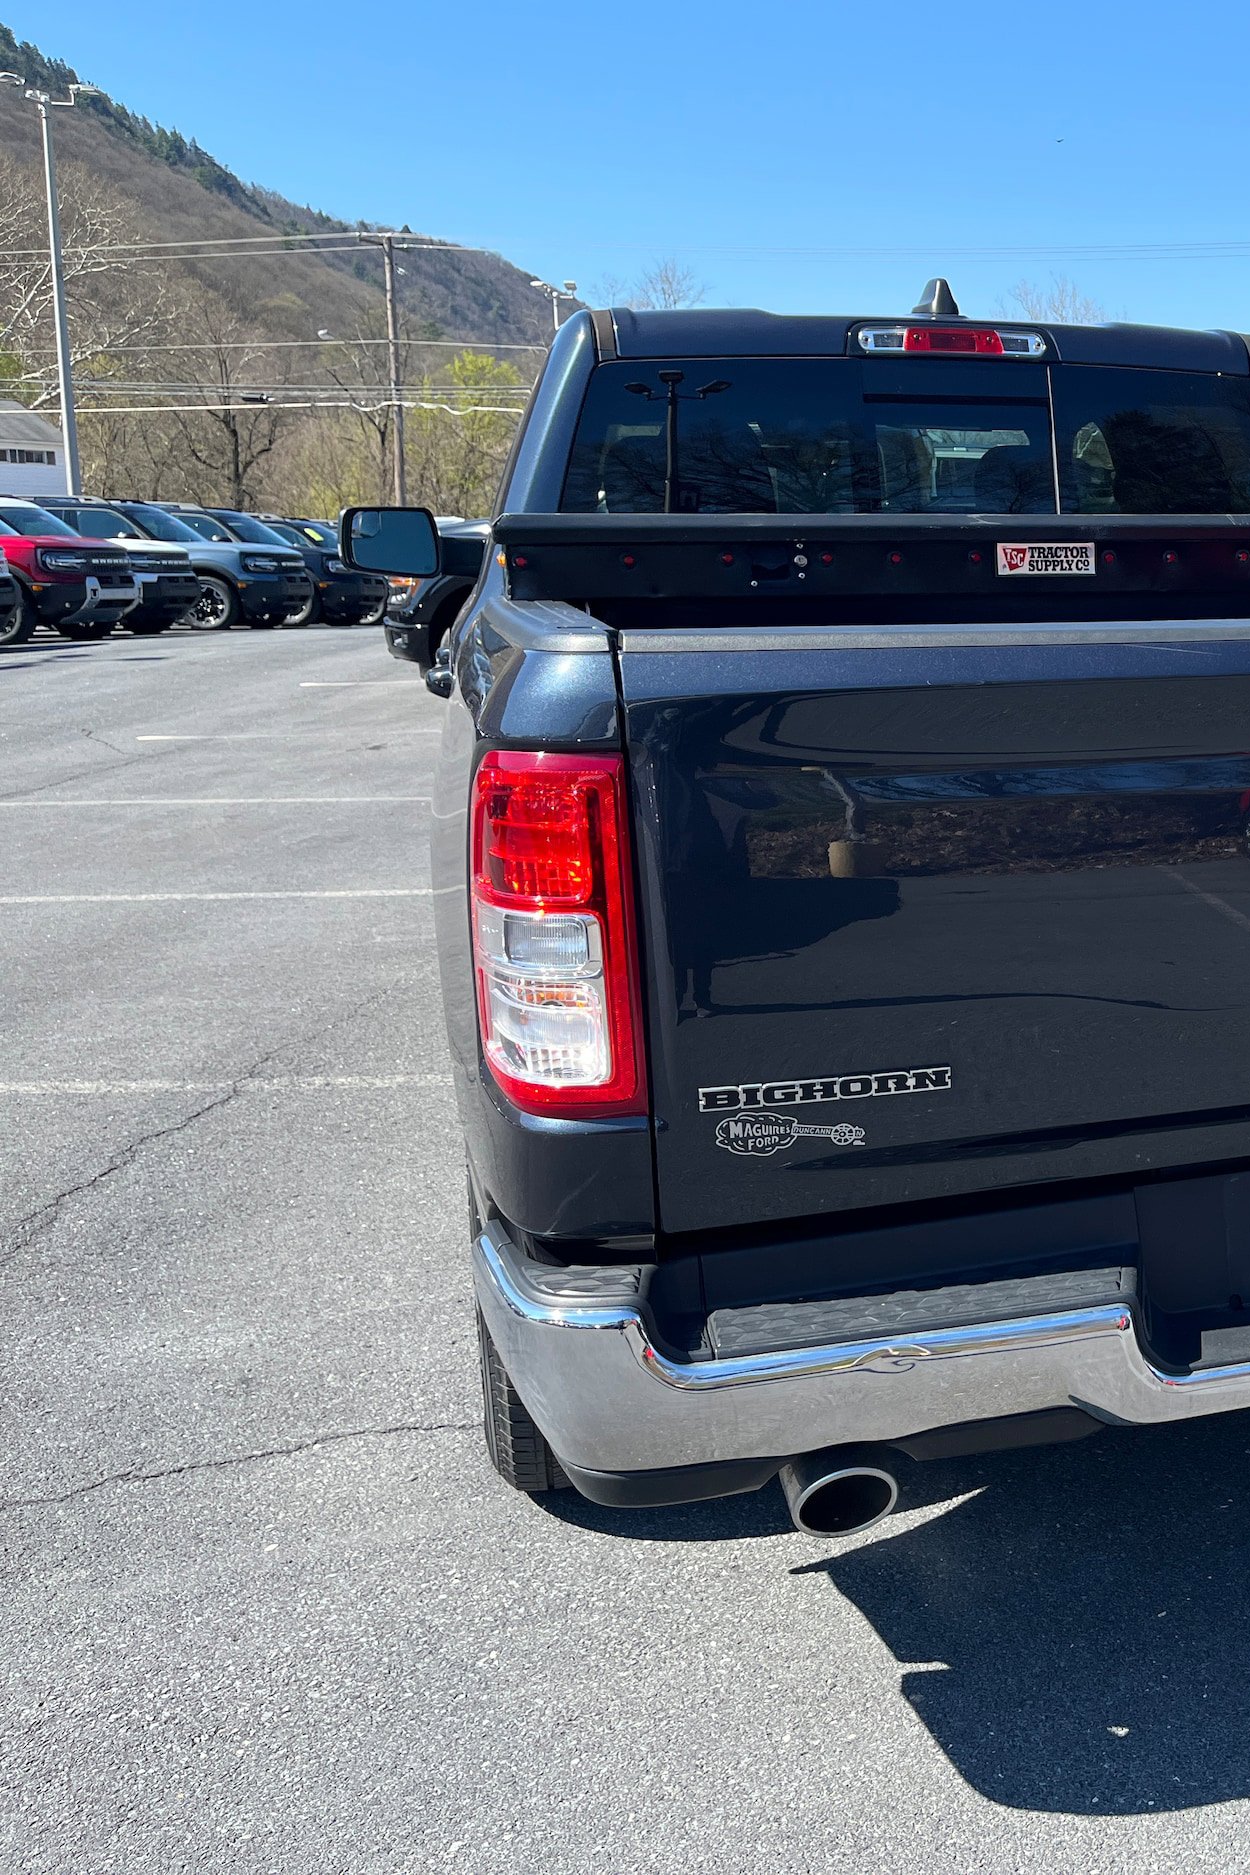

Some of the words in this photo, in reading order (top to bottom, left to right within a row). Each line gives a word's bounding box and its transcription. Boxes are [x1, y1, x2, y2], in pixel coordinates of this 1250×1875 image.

[1005, 548, 1024, 567] TSC
[1028, 546, 1089, 559] TRACTOR
[1028, 559, 1074, 572] SUPPLY
[698, 1066, 952, 1113] BIGHORN
[748, 1135, 780, 1151] FORD
